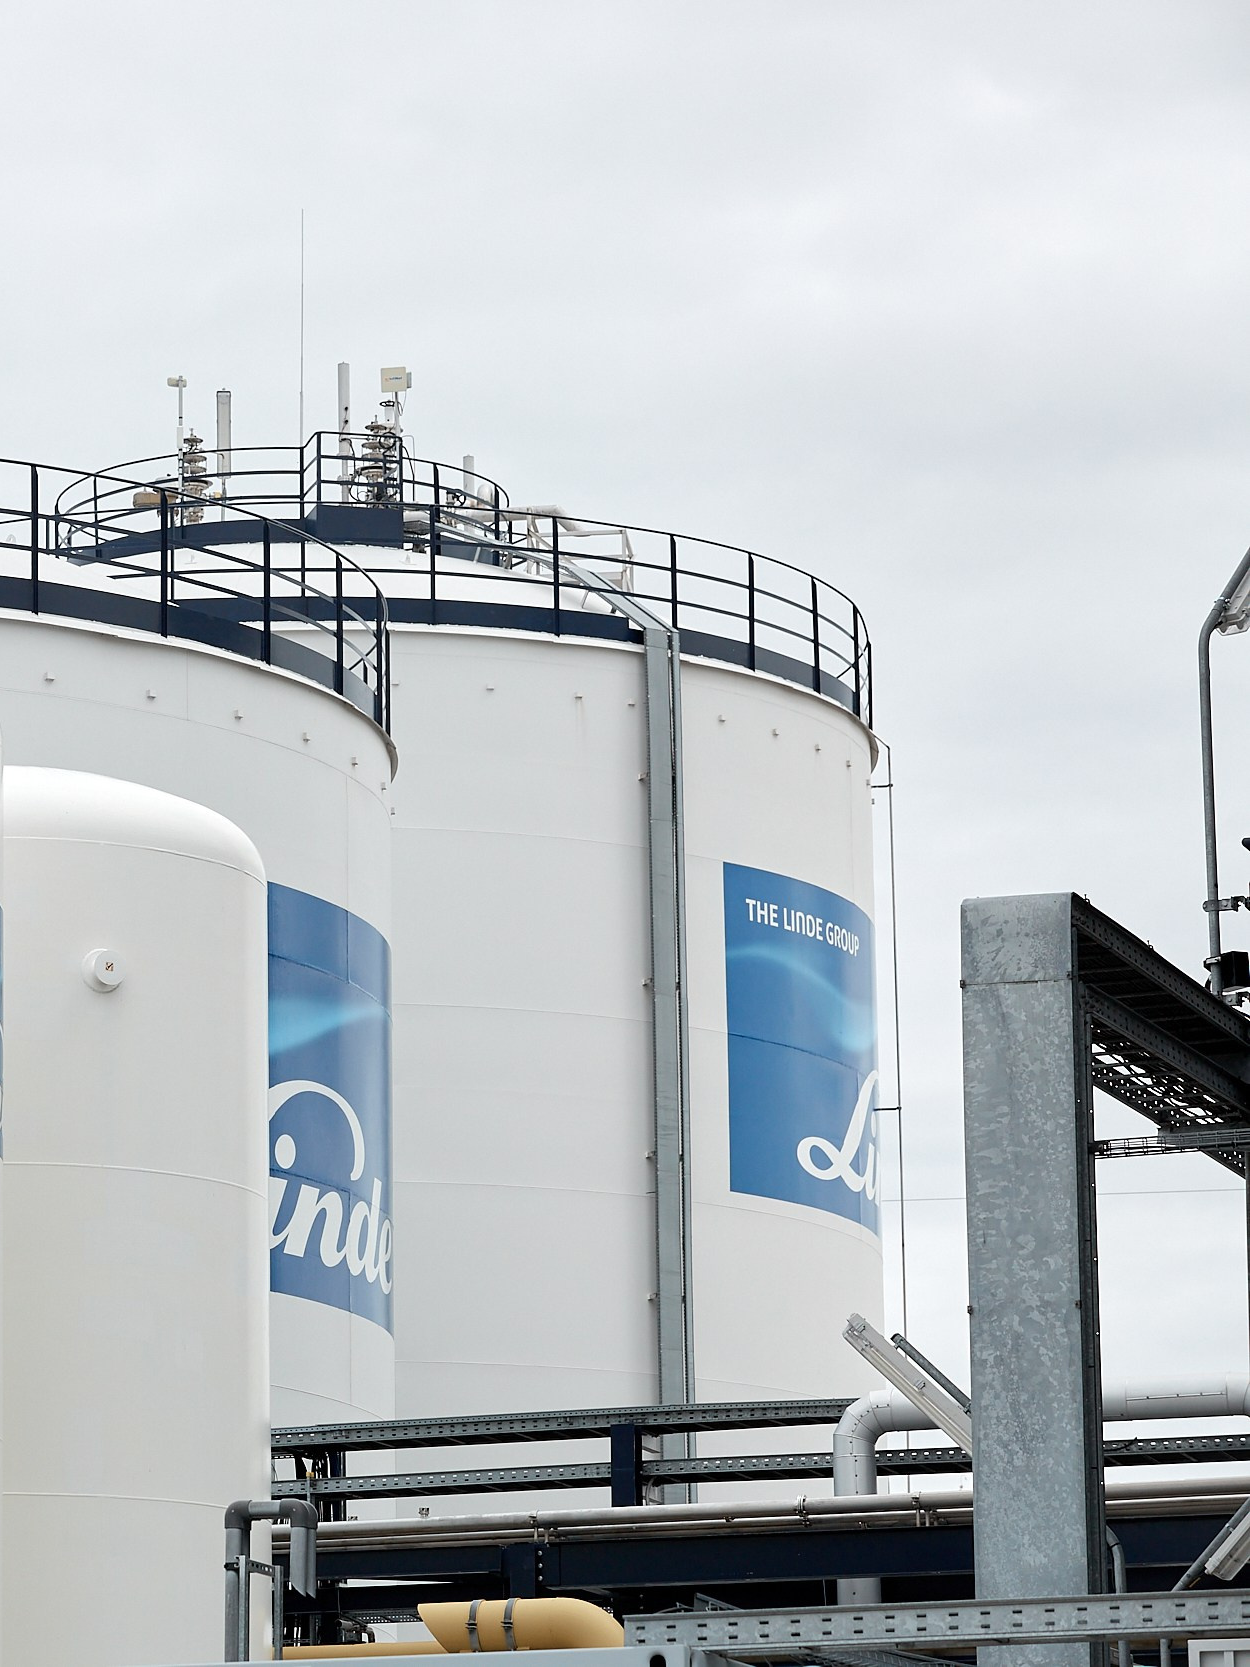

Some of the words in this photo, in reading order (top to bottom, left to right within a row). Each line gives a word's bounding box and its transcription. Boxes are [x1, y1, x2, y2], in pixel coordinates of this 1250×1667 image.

[746, 898, 779, 928] THE
[784, 908, 824, 941] LINDE
[826, 922, 859, 957] GROUP
